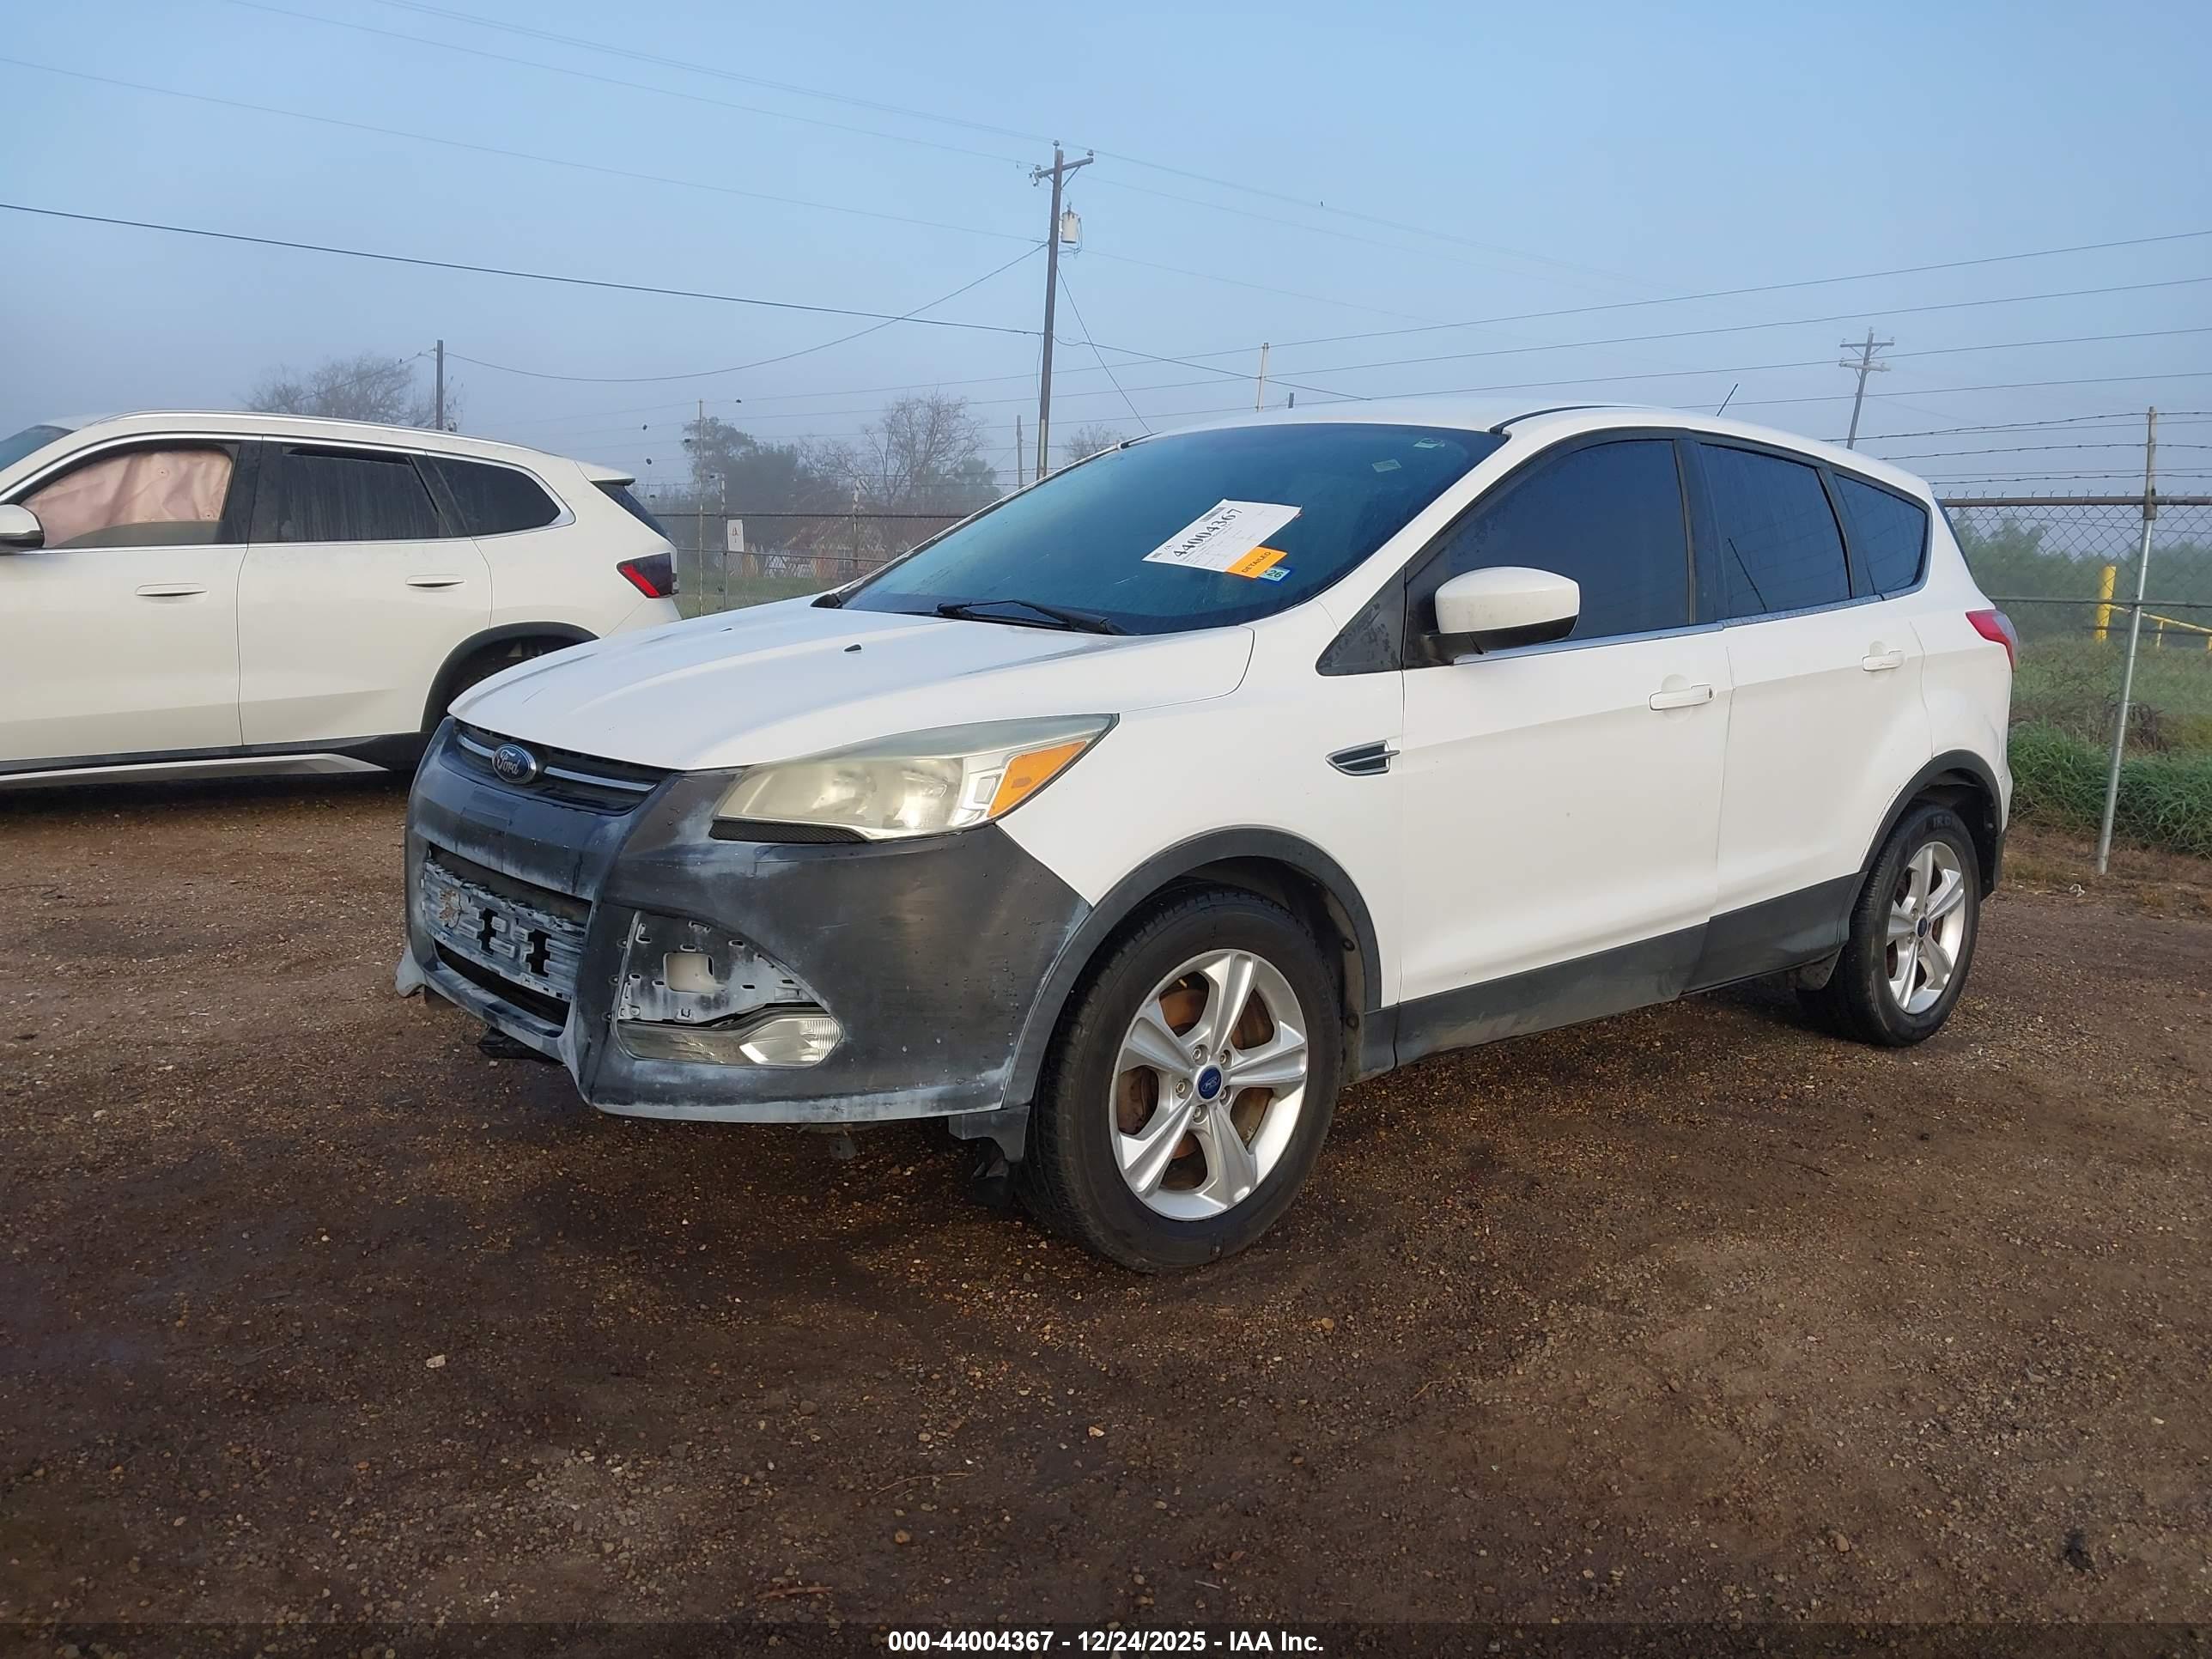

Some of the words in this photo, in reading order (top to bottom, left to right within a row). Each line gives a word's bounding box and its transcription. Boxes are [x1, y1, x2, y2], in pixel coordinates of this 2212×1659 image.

[1174, 508, 1243, 557] 44004367
[1242, 551, 1272, 574] DETAILED
[1267, 569, 1284, 578] 26
[496, 749, 521, 775] Ford
